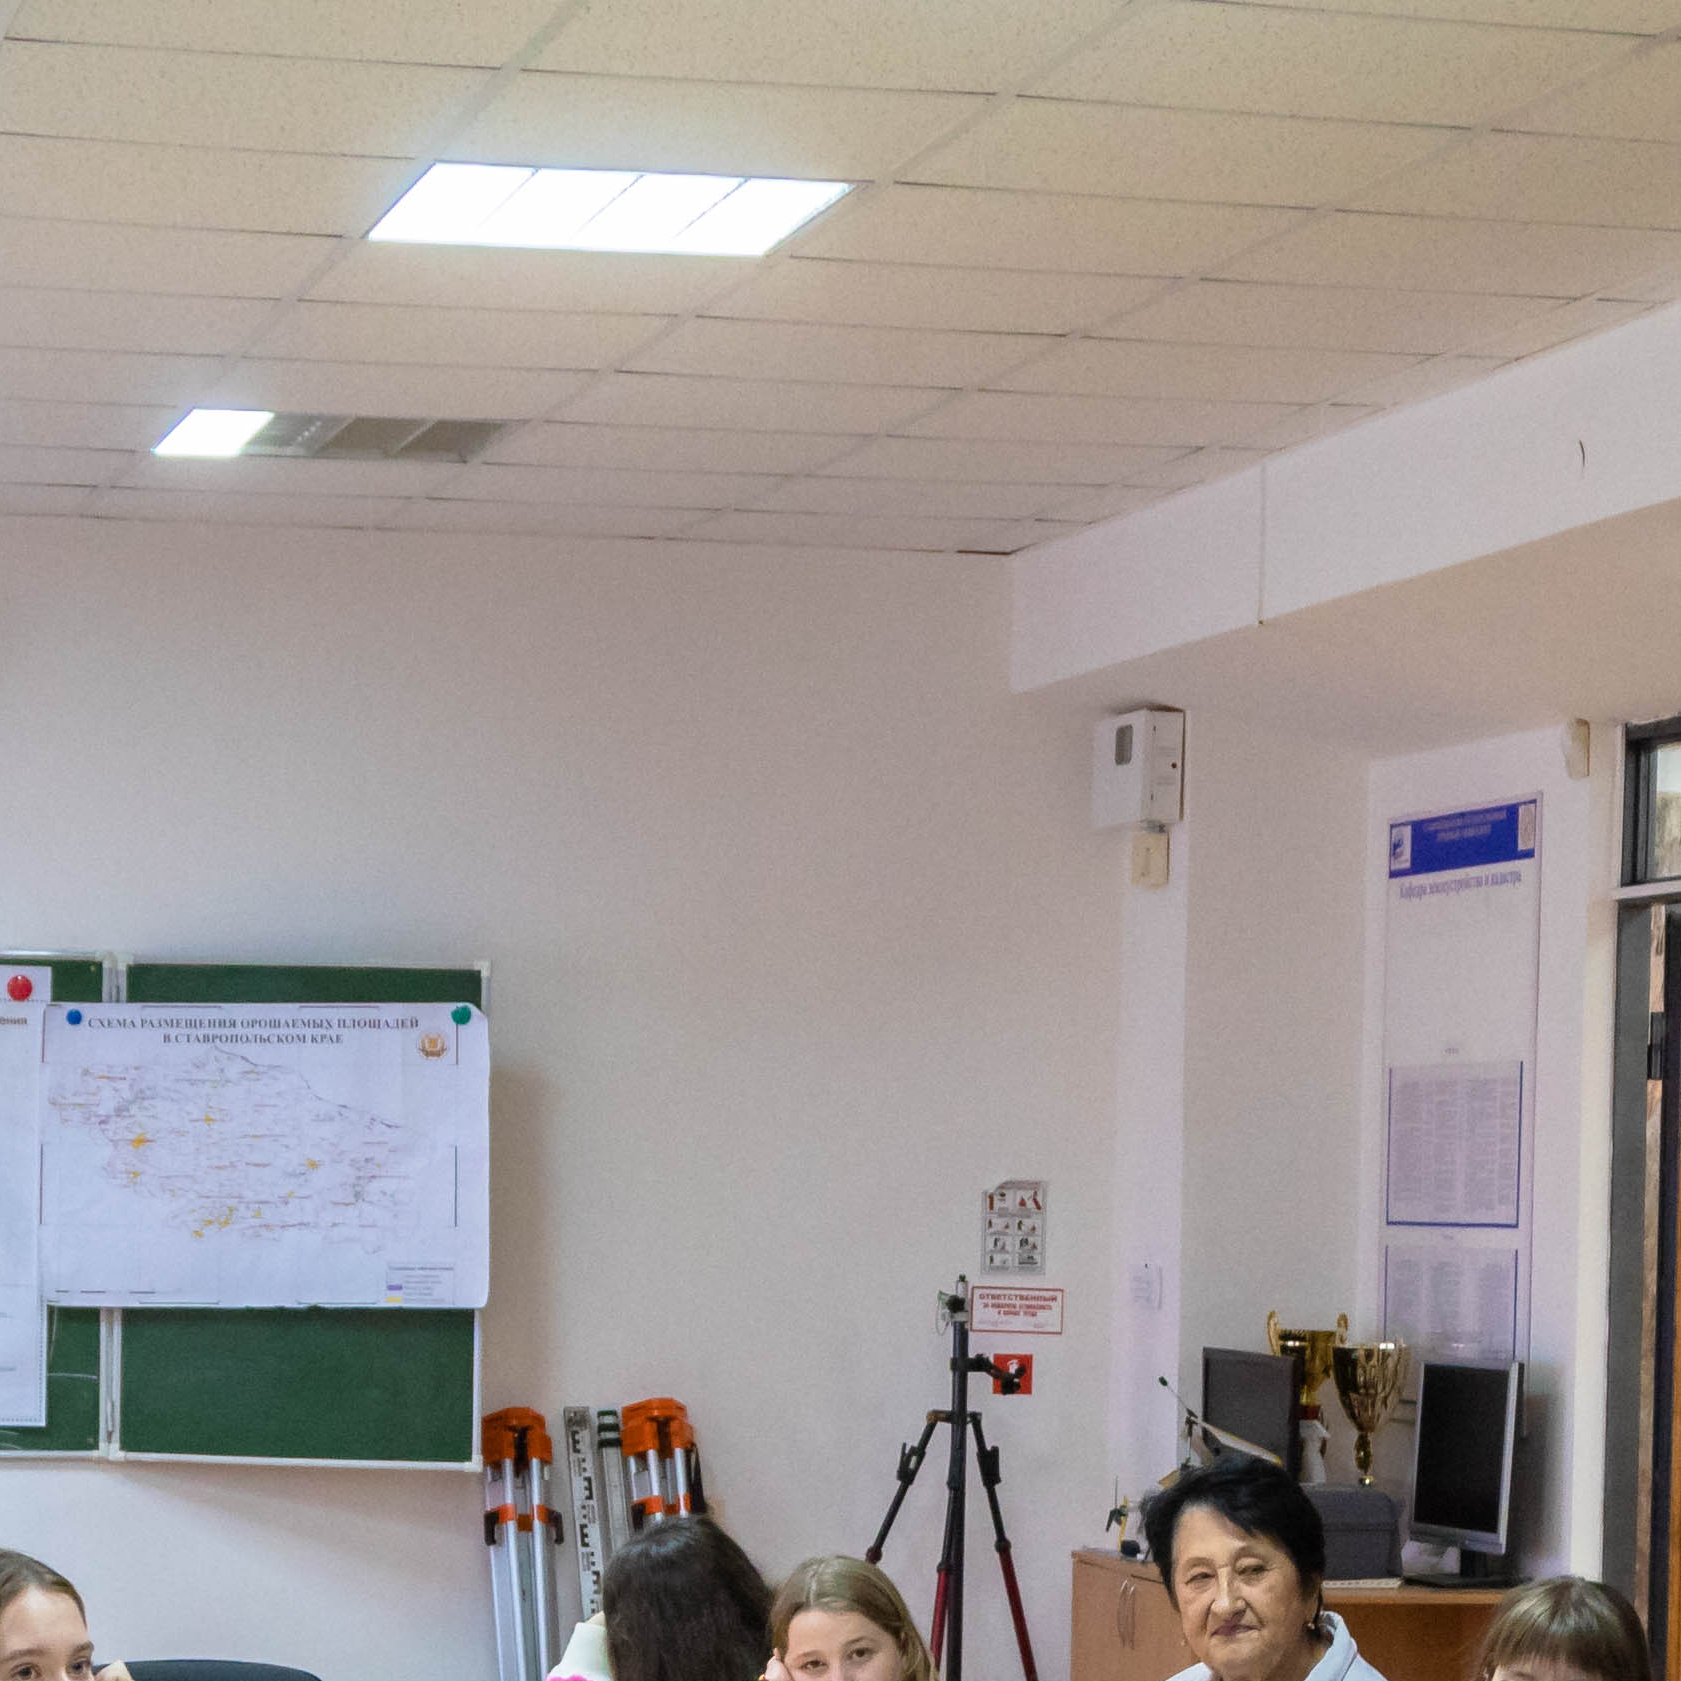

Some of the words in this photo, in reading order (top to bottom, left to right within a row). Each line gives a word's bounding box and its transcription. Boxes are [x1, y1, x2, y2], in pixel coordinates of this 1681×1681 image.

[88, 1017, 136, 1030] СХЕМА
[140, 1017, 237, 1031] РАЗМЕЩЕНИЯ
[240, 1017, 333, 1031] ОРОШАЕМЫХ
[337, 1015, 419, 1031] ПЛОЩАДЕЙ
[163, 1033, 171, 1045] В
[175, 1033, 307, 1046] СТАВРОПОЛЬСКОМ
[310, 1033, 344, 1045] КРАЕ
